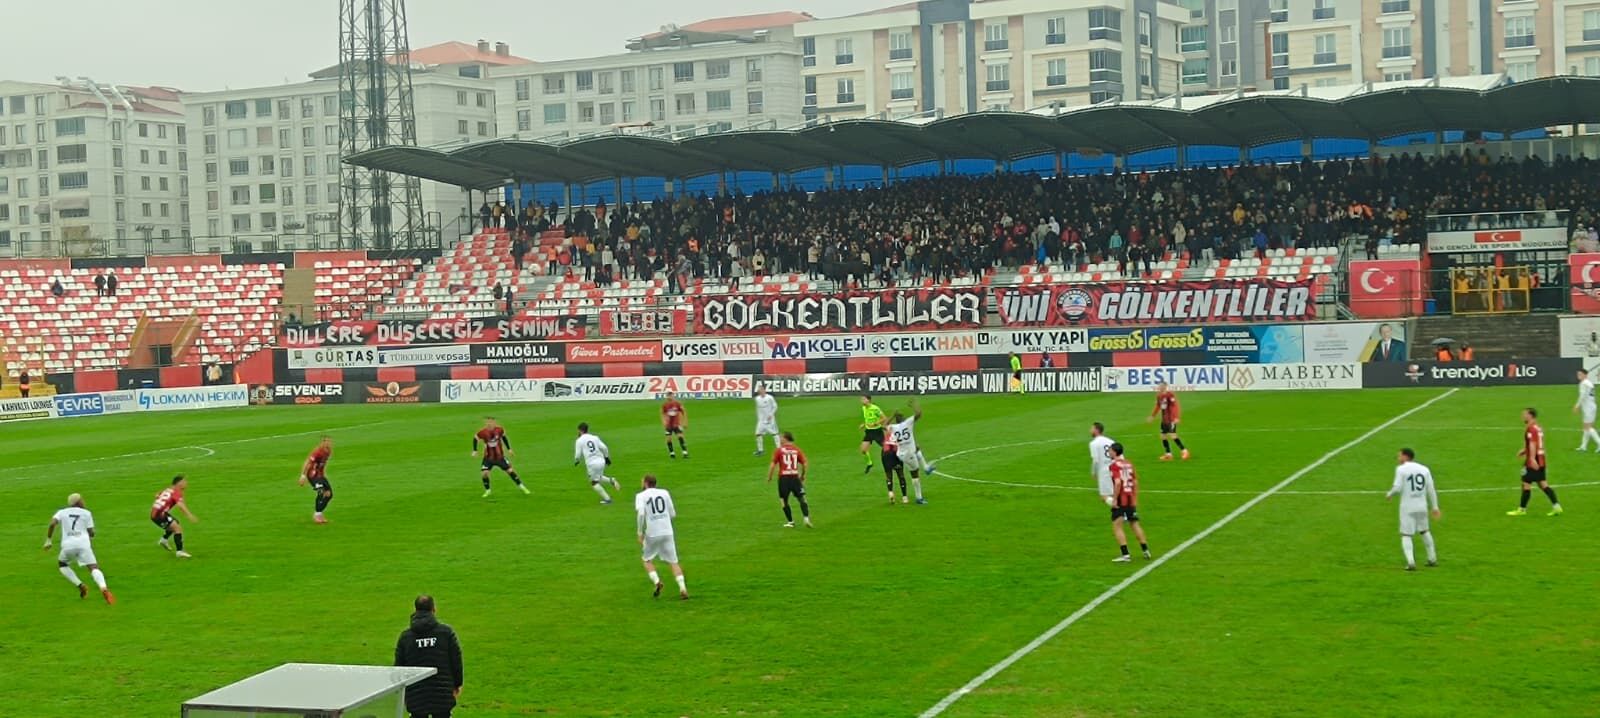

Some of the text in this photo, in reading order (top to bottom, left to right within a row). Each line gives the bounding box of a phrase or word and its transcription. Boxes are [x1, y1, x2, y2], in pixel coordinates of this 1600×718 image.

[1098, 284, 1308, 320] GÖLKENTLİLER
[703, 291, 981, 330] GÖLKENTLİLER
[286, 324, 364, 344] DİLLERE
[1012, 331, 1084, 346] UKY YAPI
[486, 343, 548, 357] HANOĞLU
[722, 342, 763, 355] VESTEL
[315, 349, 374, 364] GÜRTAŞ
[1127, 367, 1224, 386] BEST VAN
[1262, 364, 1356, 380] MABEYN
[1431, 365, 1503, 380] trendyol
[469, 380, 538, 392] MARYAP
[648, 377, 678, 392] 2A
[982, 373, 1003, 392] VAN
[1059, 368, 1100, 391] KONAĞI
[275, 384, 343, 396] SEVENLER
[585, 382, 645, 395] VANGÖLÜ
[56, 397, 102, 414] ÇEVRE
[152, 391, 204, 405] LOKMAN
[894, 427, 911, 443] 25
[586, 440, 596, 453] 9
[782, 453, 798, 470] 41
[1407, 473, 1425, 492] 19
[646, 495, 666, 514] 10
[68, 514, 80, 531] 7
[415, 637, 437, 648] TFF
